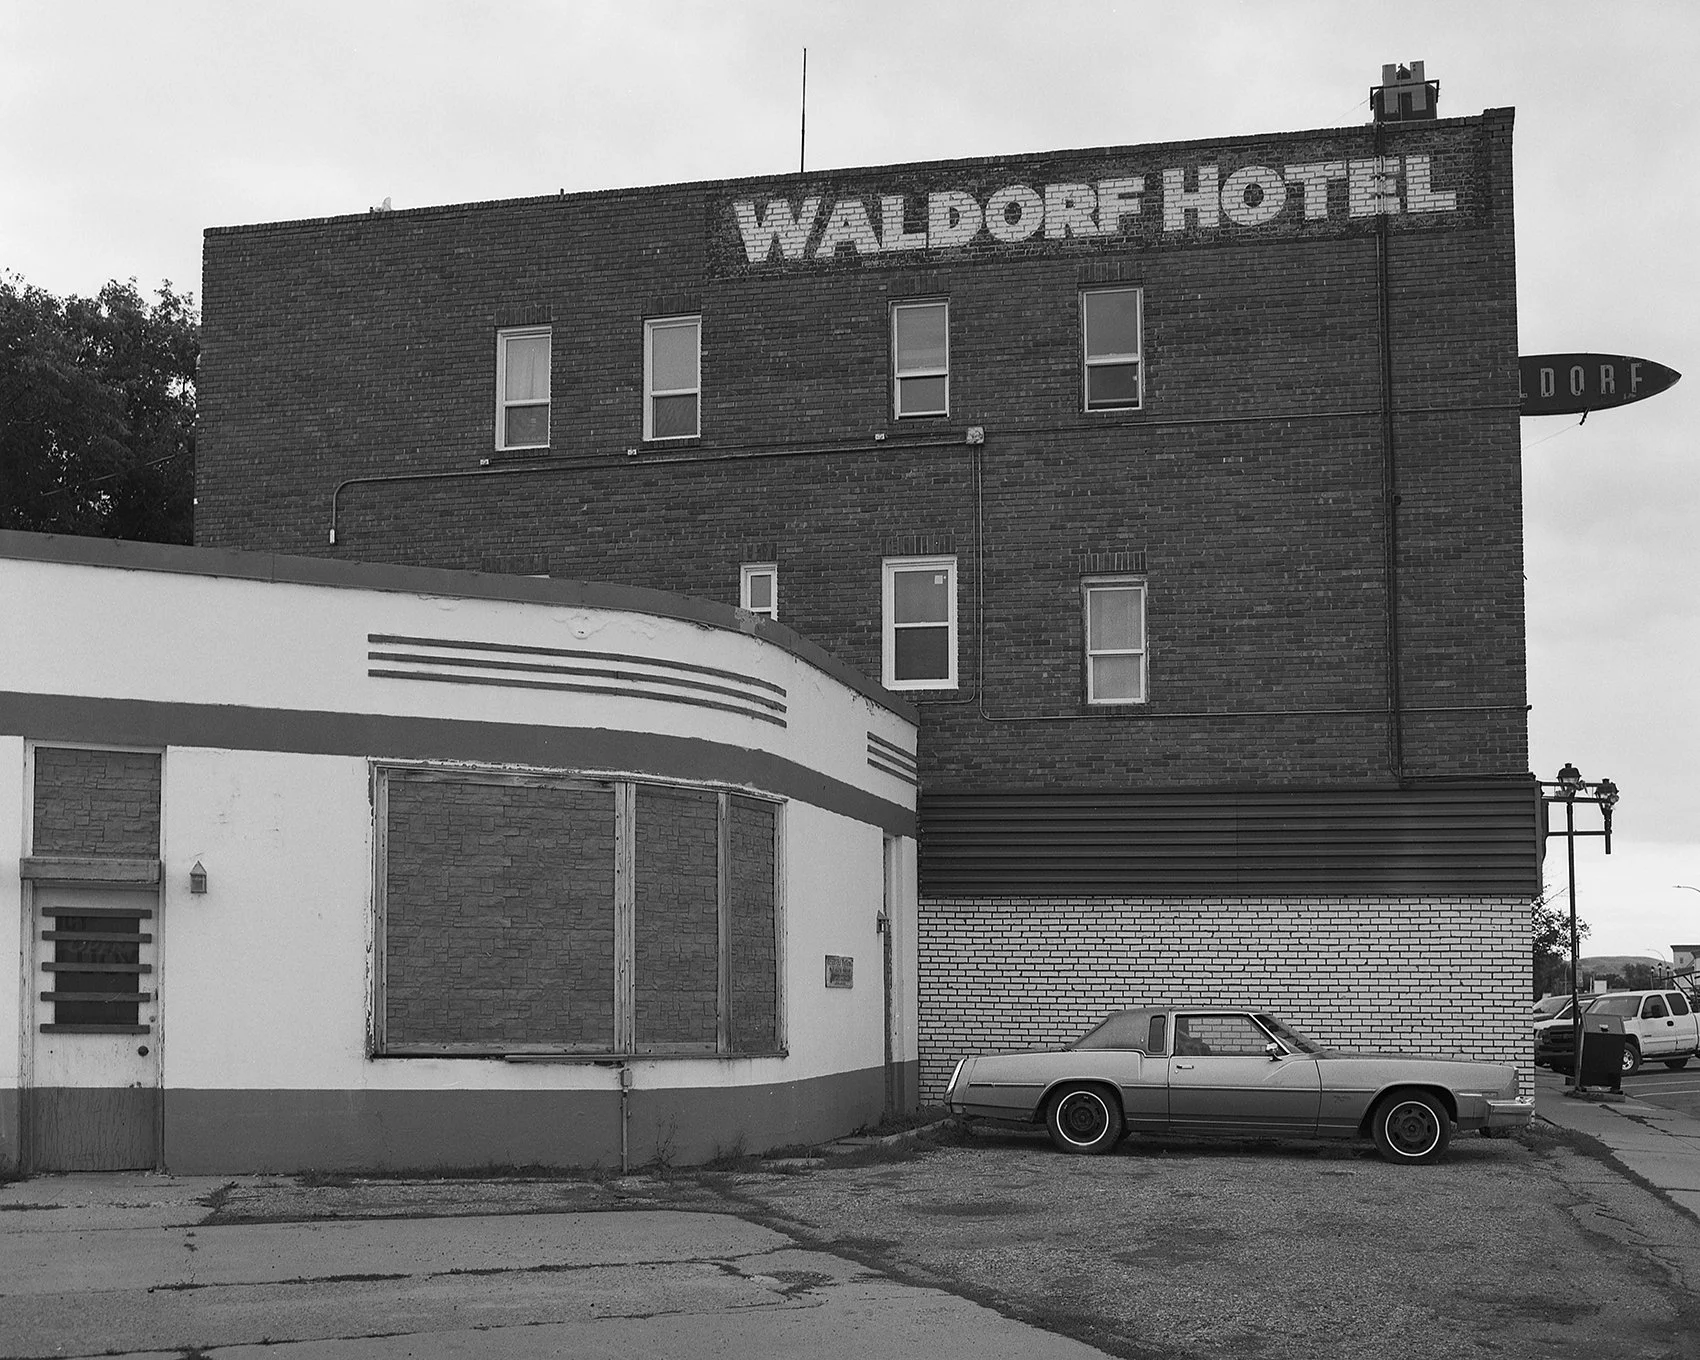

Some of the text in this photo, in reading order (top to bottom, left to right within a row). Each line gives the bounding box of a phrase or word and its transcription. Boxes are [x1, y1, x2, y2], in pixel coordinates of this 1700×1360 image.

[1382, 60, 1427, 114] H
[732, 154, 1457, 263] WALDORF HOTEL
